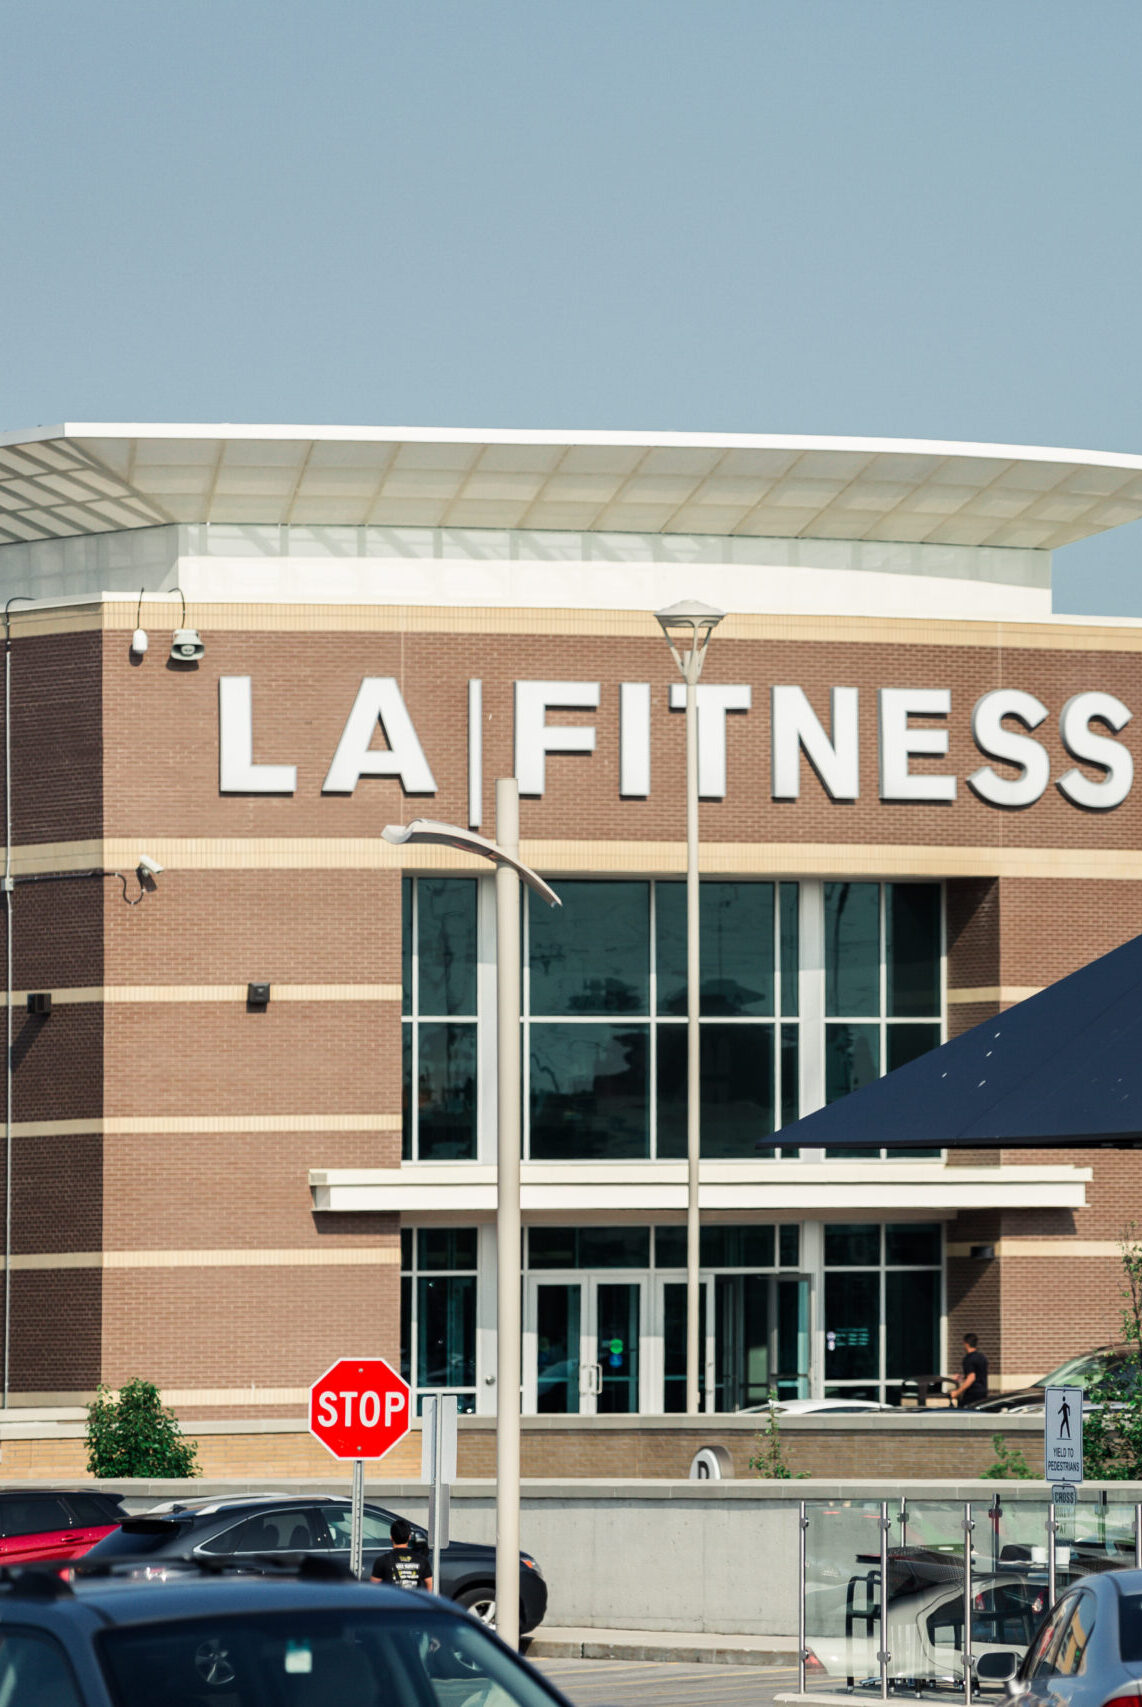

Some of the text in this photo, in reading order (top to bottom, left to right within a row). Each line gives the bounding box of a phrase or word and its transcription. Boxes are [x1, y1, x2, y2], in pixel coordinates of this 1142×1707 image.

[219, 676, 1135, 810] LA FITNESS
[317, 1390, 406, 1428] STOP
[1053, 1447, 1074, 1458] YIELD TO
[1048, 1461, 1080, 1472] PEDESTRIANS
[1054, 1491, 1075, 1504] CROSS
